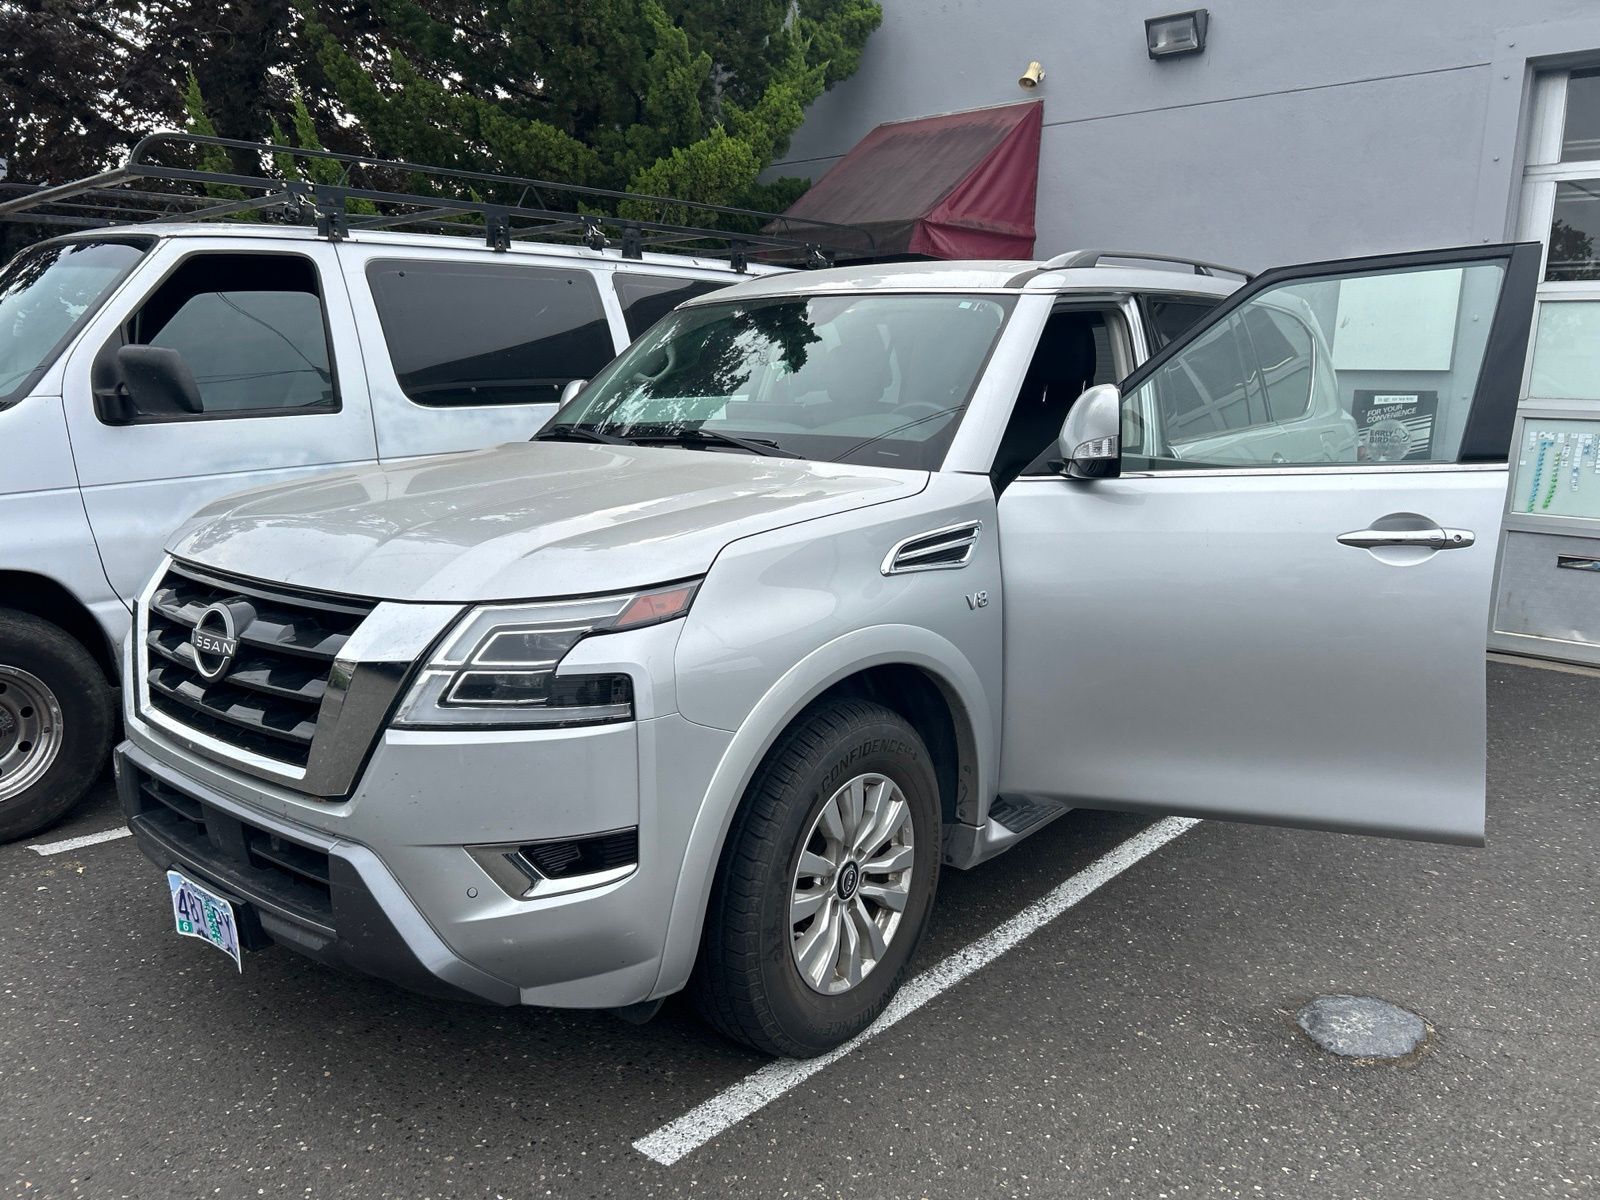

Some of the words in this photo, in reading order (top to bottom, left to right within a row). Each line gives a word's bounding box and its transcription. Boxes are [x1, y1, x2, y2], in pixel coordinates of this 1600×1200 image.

[1367, 408, 1381, 417] FOR
[1383, 404, 1403, 412] YOUR
[1367, 407, 1417, 423] CONVENIENCE
[965, 590, 988, 610] V8
[195, 635, 234, 655] SSAN
[179, 888, 207, 929] 487
[183, 922, 189, 931] 6
